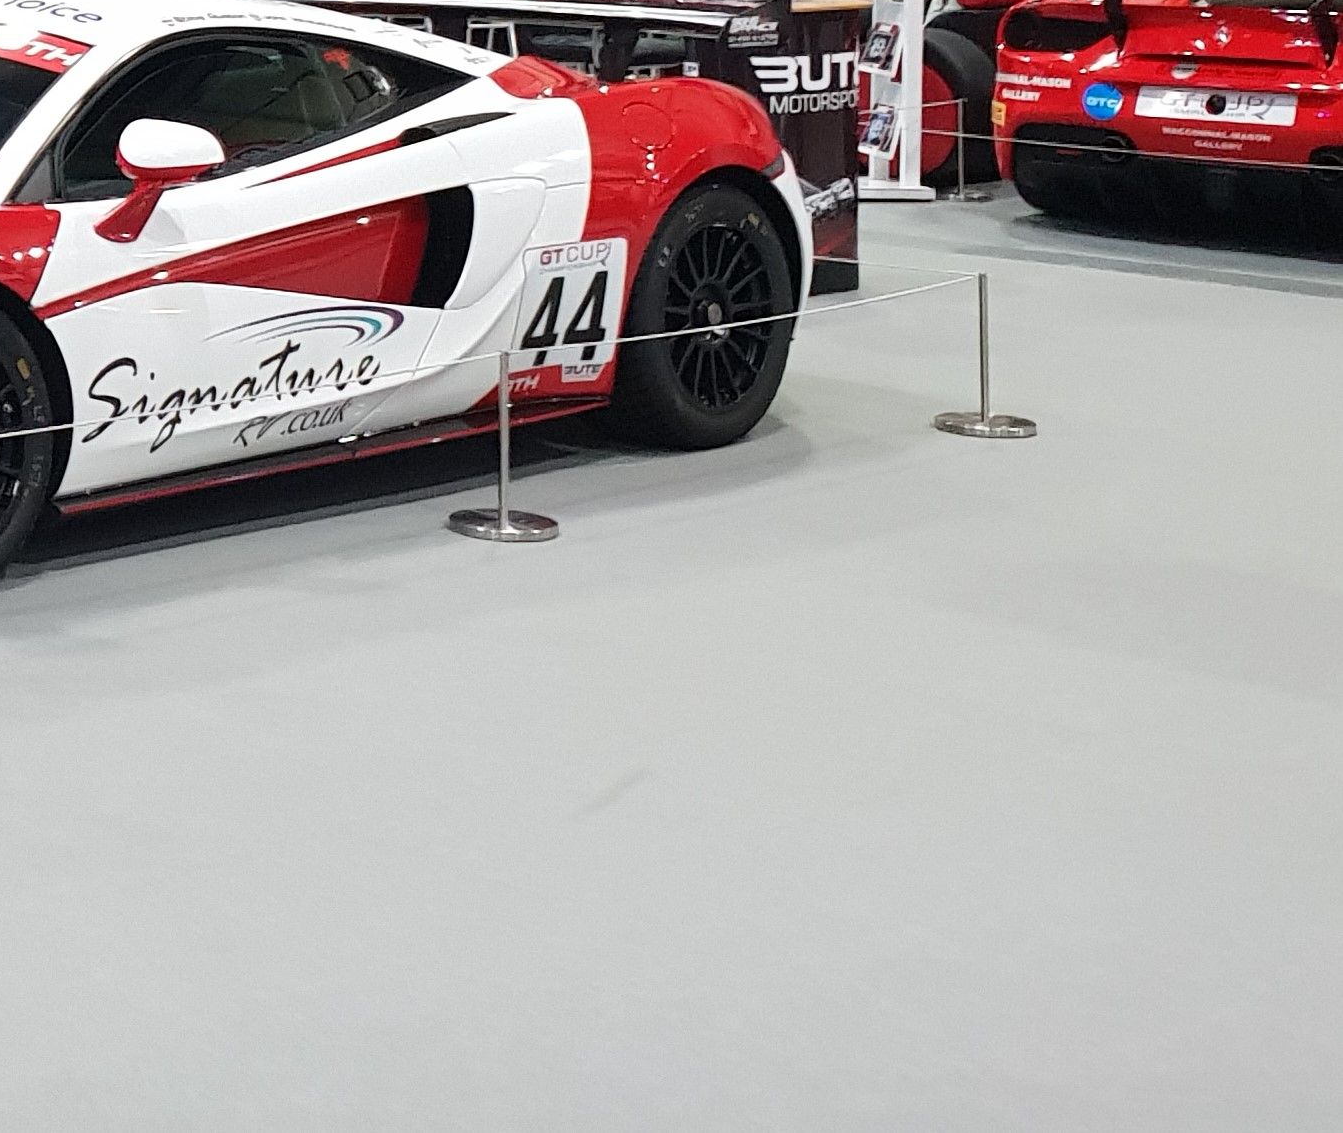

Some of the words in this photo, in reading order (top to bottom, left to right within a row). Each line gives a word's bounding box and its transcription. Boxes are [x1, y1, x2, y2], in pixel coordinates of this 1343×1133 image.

[540, 248, 564, 265] GT
[566, 242, 608, 263] CUP
[520, 270, 609, 366] 44
[81, 338, 381, 454] Signature
[564, 363, 602, 375] BUTE
